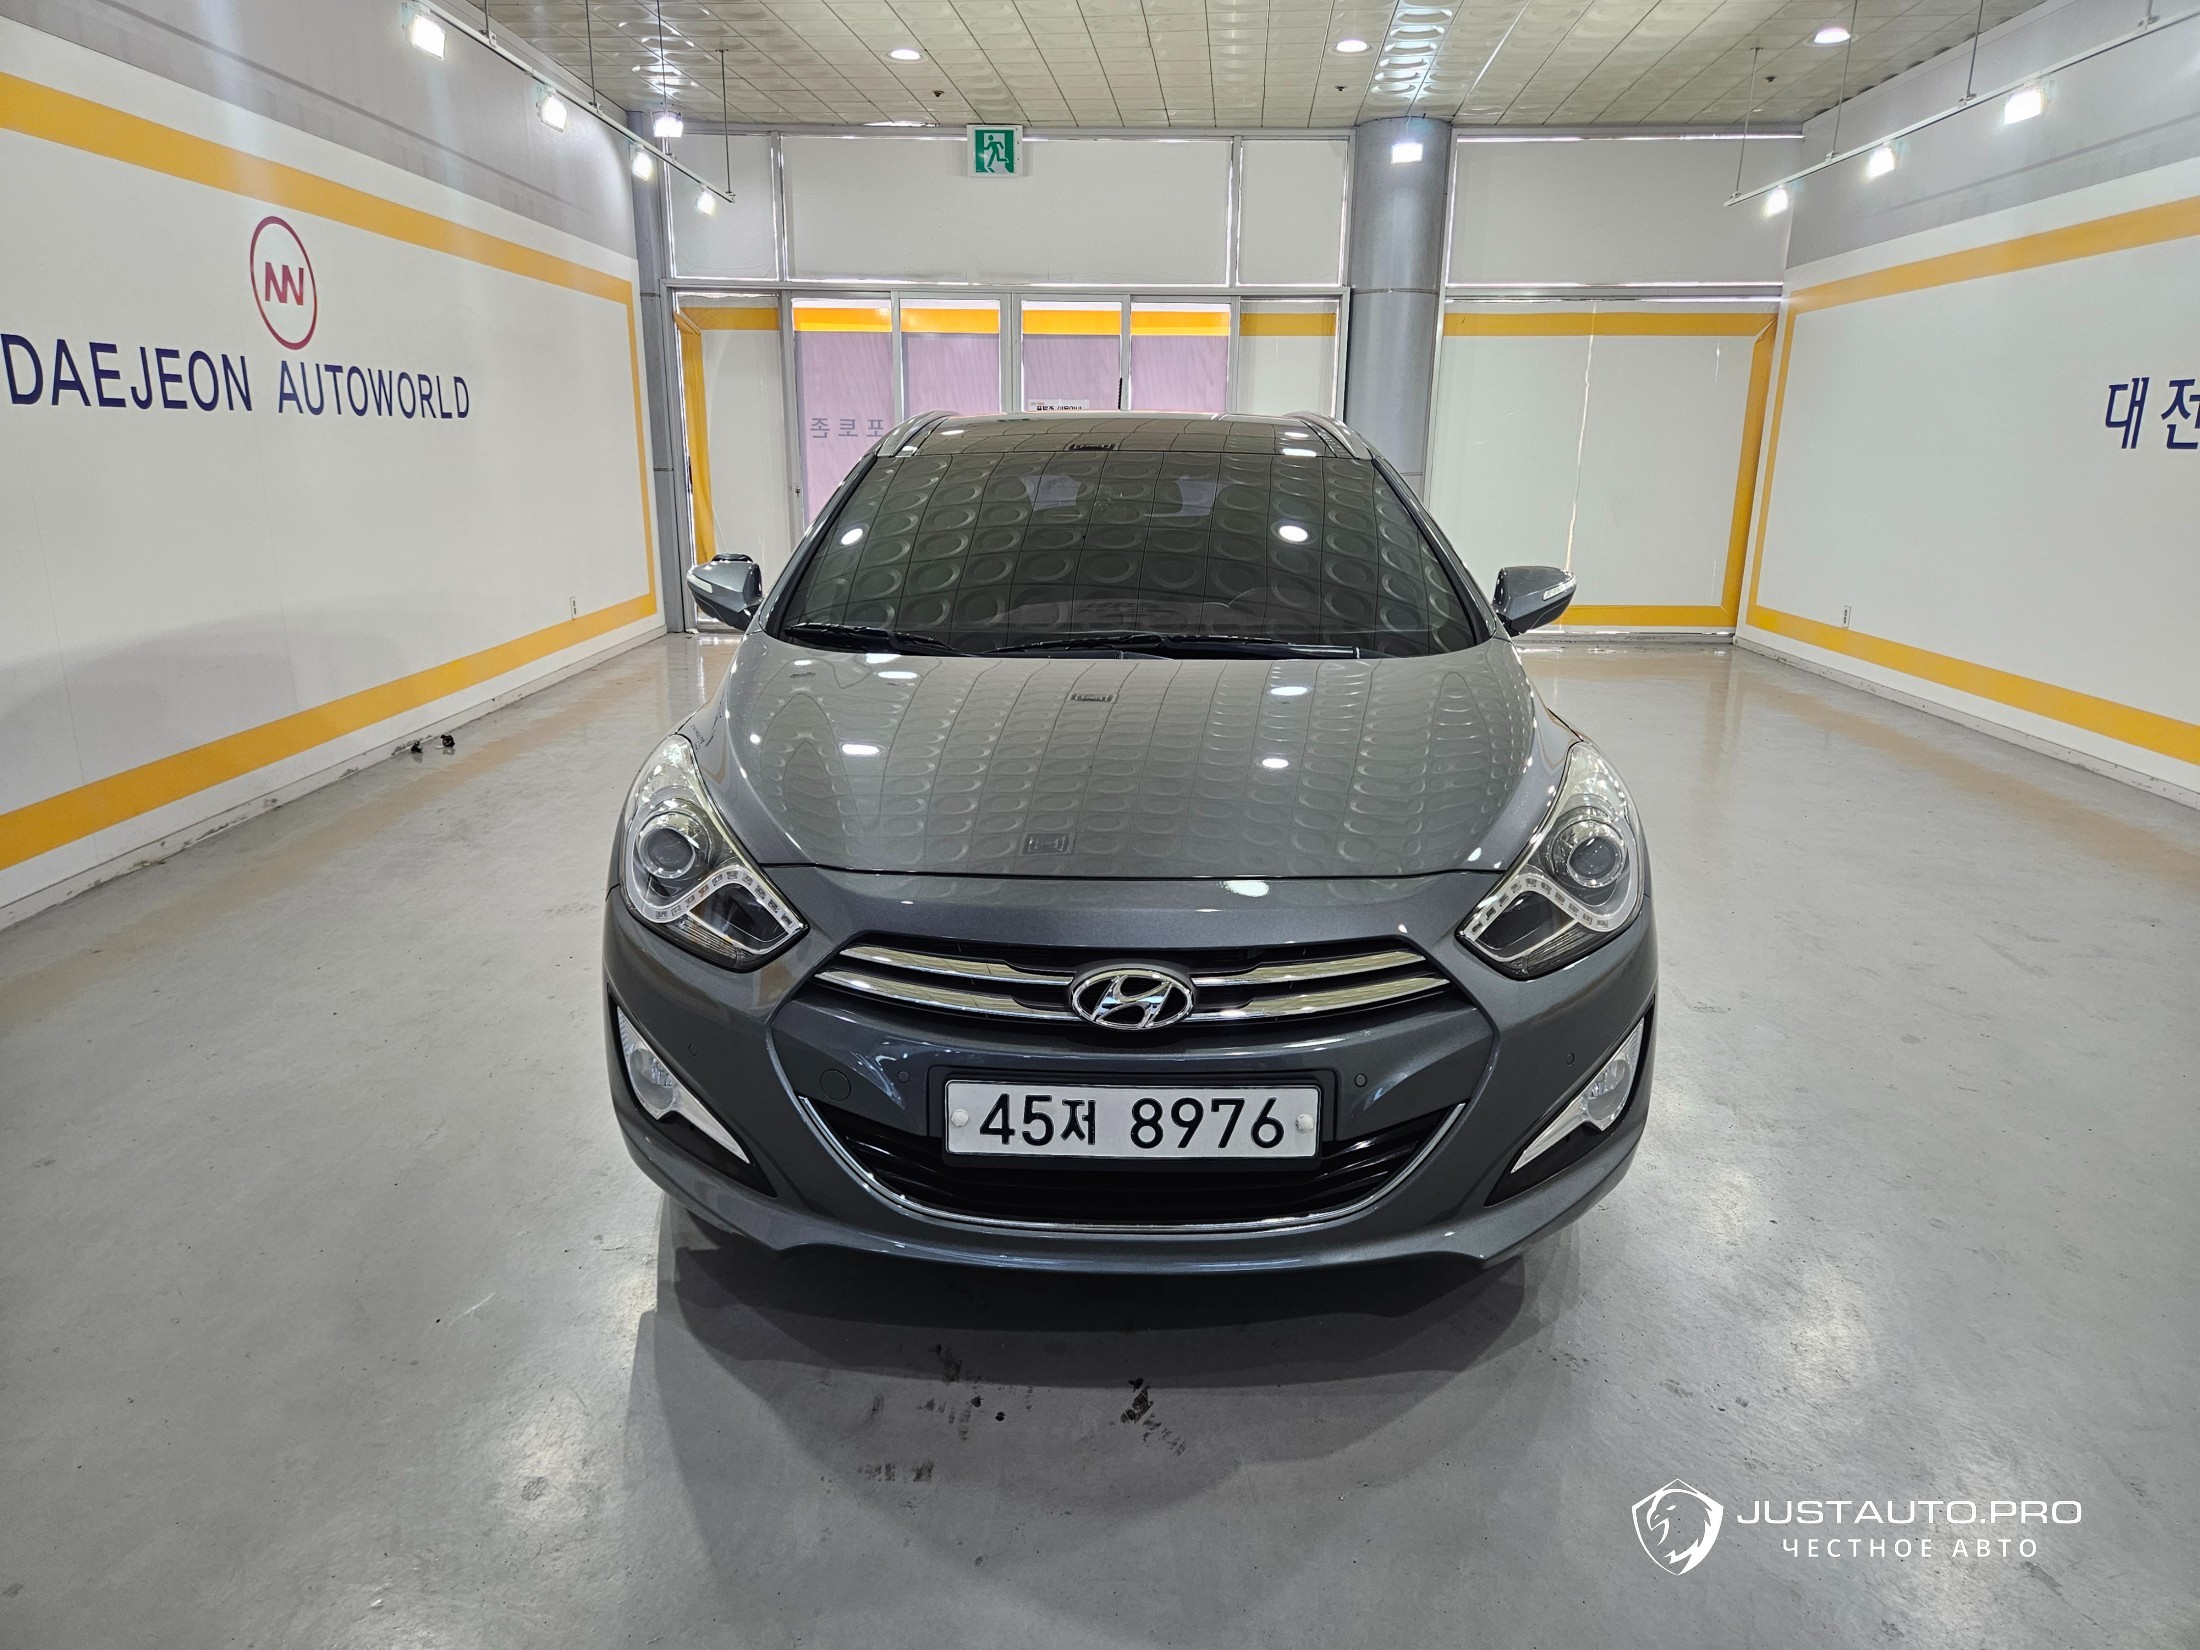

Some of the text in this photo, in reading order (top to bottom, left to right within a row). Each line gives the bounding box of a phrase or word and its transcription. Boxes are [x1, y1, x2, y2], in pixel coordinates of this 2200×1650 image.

[0, 333, 470, 419] DAEJEON AUTOWORLD
[979, 1093, 1285, 1149] 45저 8976
